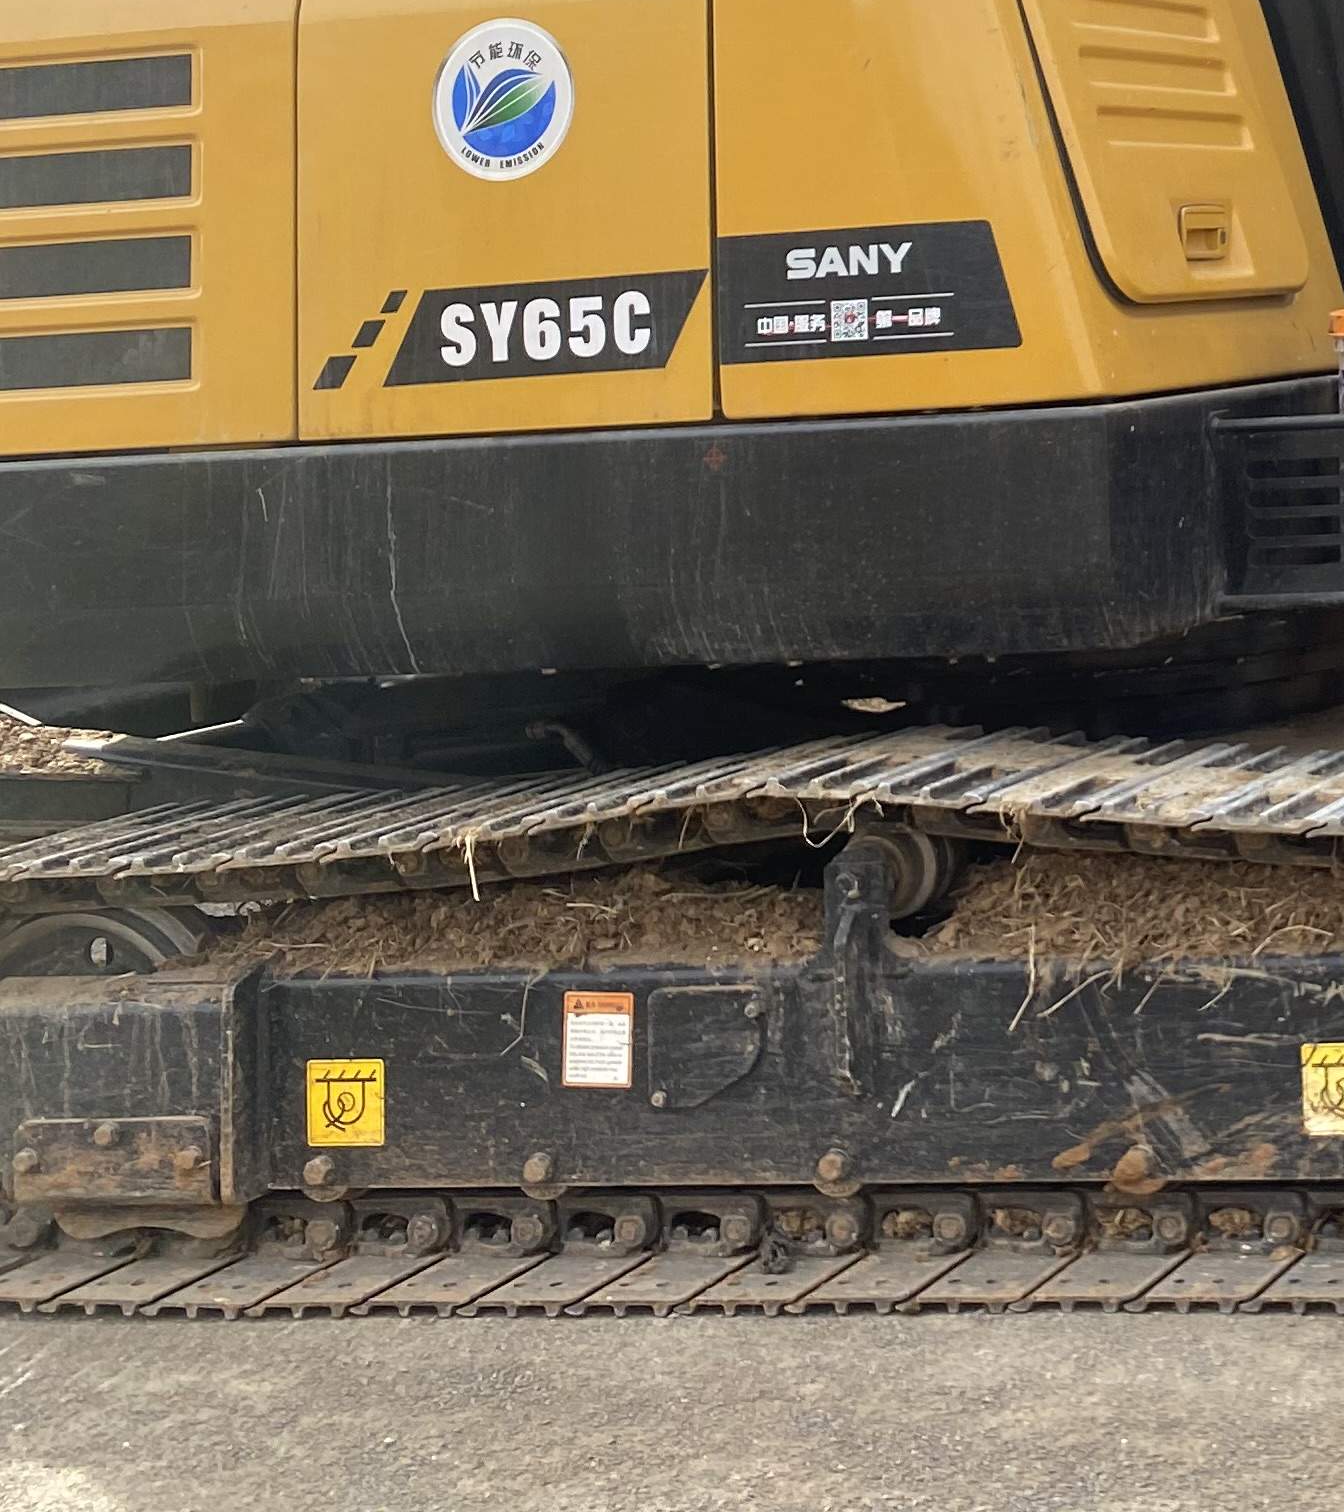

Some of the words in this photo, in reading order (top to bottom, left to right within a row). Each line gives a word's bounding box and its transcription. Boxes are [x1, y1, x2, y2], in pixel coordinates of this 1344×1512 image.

[469, 40, 542, 70] 节能环保
[461, 145, 491, 168] LOWER
[499, 141, 545, 169] EMISSION
[786, 241, 913, 281] SANY
[439, 290, 653, 367] SY65C
